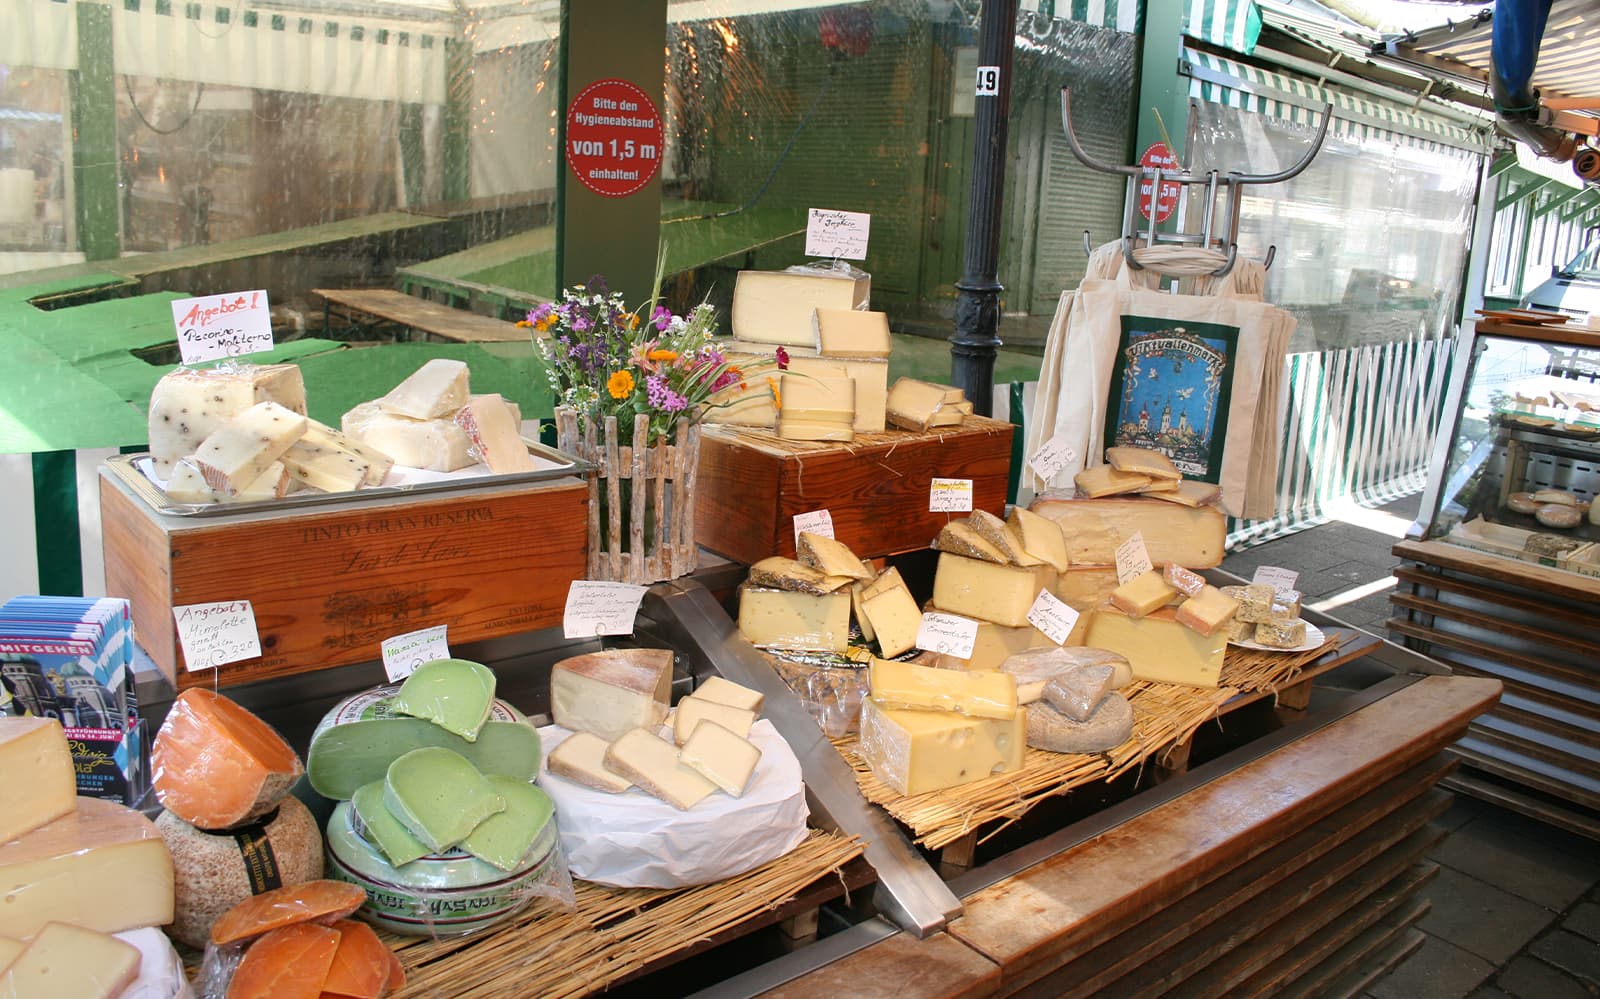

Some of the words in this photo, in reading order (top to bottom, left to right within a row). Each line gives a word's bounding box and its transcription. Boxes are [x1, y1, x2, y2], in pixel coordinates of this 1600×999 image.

[593, 97, 617, 109] Bitte
[619, 100, 638, 111] den
[576, 112, 654, 128] Hygieneabstand
[572, 140, 603, 156] von
[609, 138, 635, 160] 1,5
[640, 144, 656, 159] m
[589, 167, 639, 180] einhalten!
[303, 521, 360, 544] TINTO
[365, 516, 417, 534] GRAN
[423, 506, 494, 528] RESERVA
[1, 644, 91, 655] MITGEHEN
[430, 895, 497, 915] WASABI
